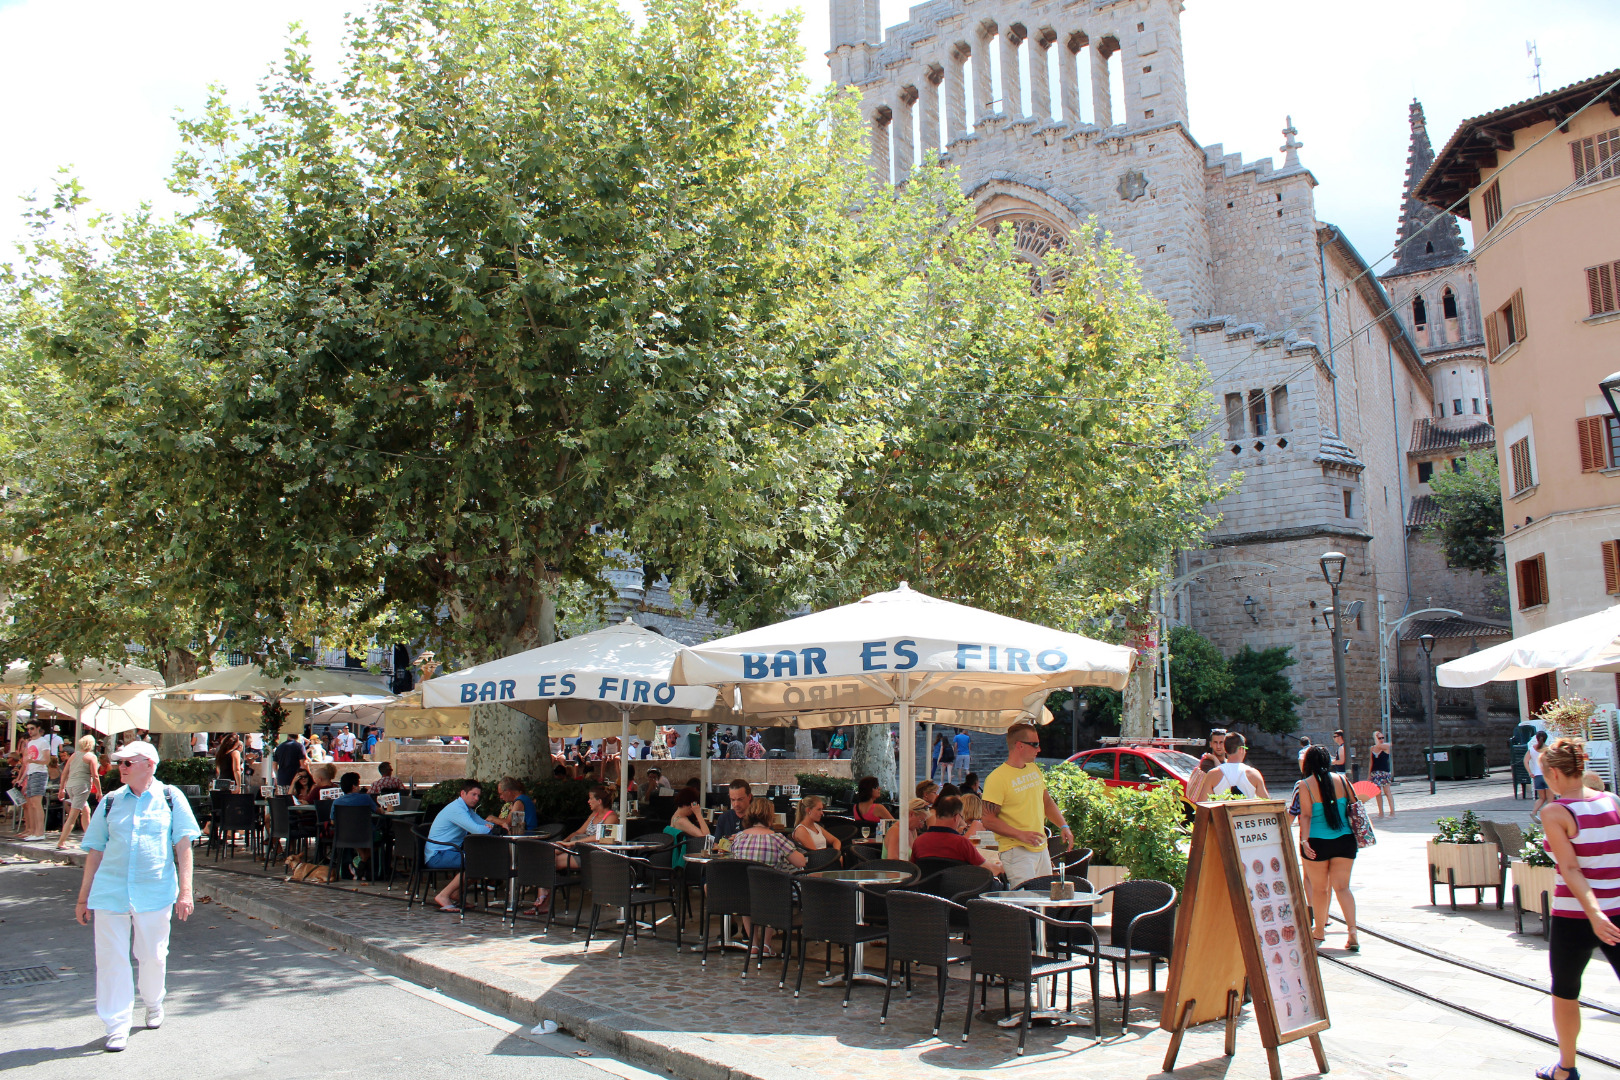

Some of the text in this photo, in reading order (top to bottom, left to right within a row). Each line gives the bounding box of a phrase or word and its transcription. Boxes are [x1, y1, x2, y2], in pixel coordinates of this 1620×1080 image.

[739, 639, 1069, 679] BAR ES FIRÓ
[460, 679, 517, 703] BAR
[537, 673, 576, 697] ES
[1244, 820, 1256, 829] ES
[1257, 817, 1278, 827] FIRO
[1240, 832, 1268, 843] TAPAS
